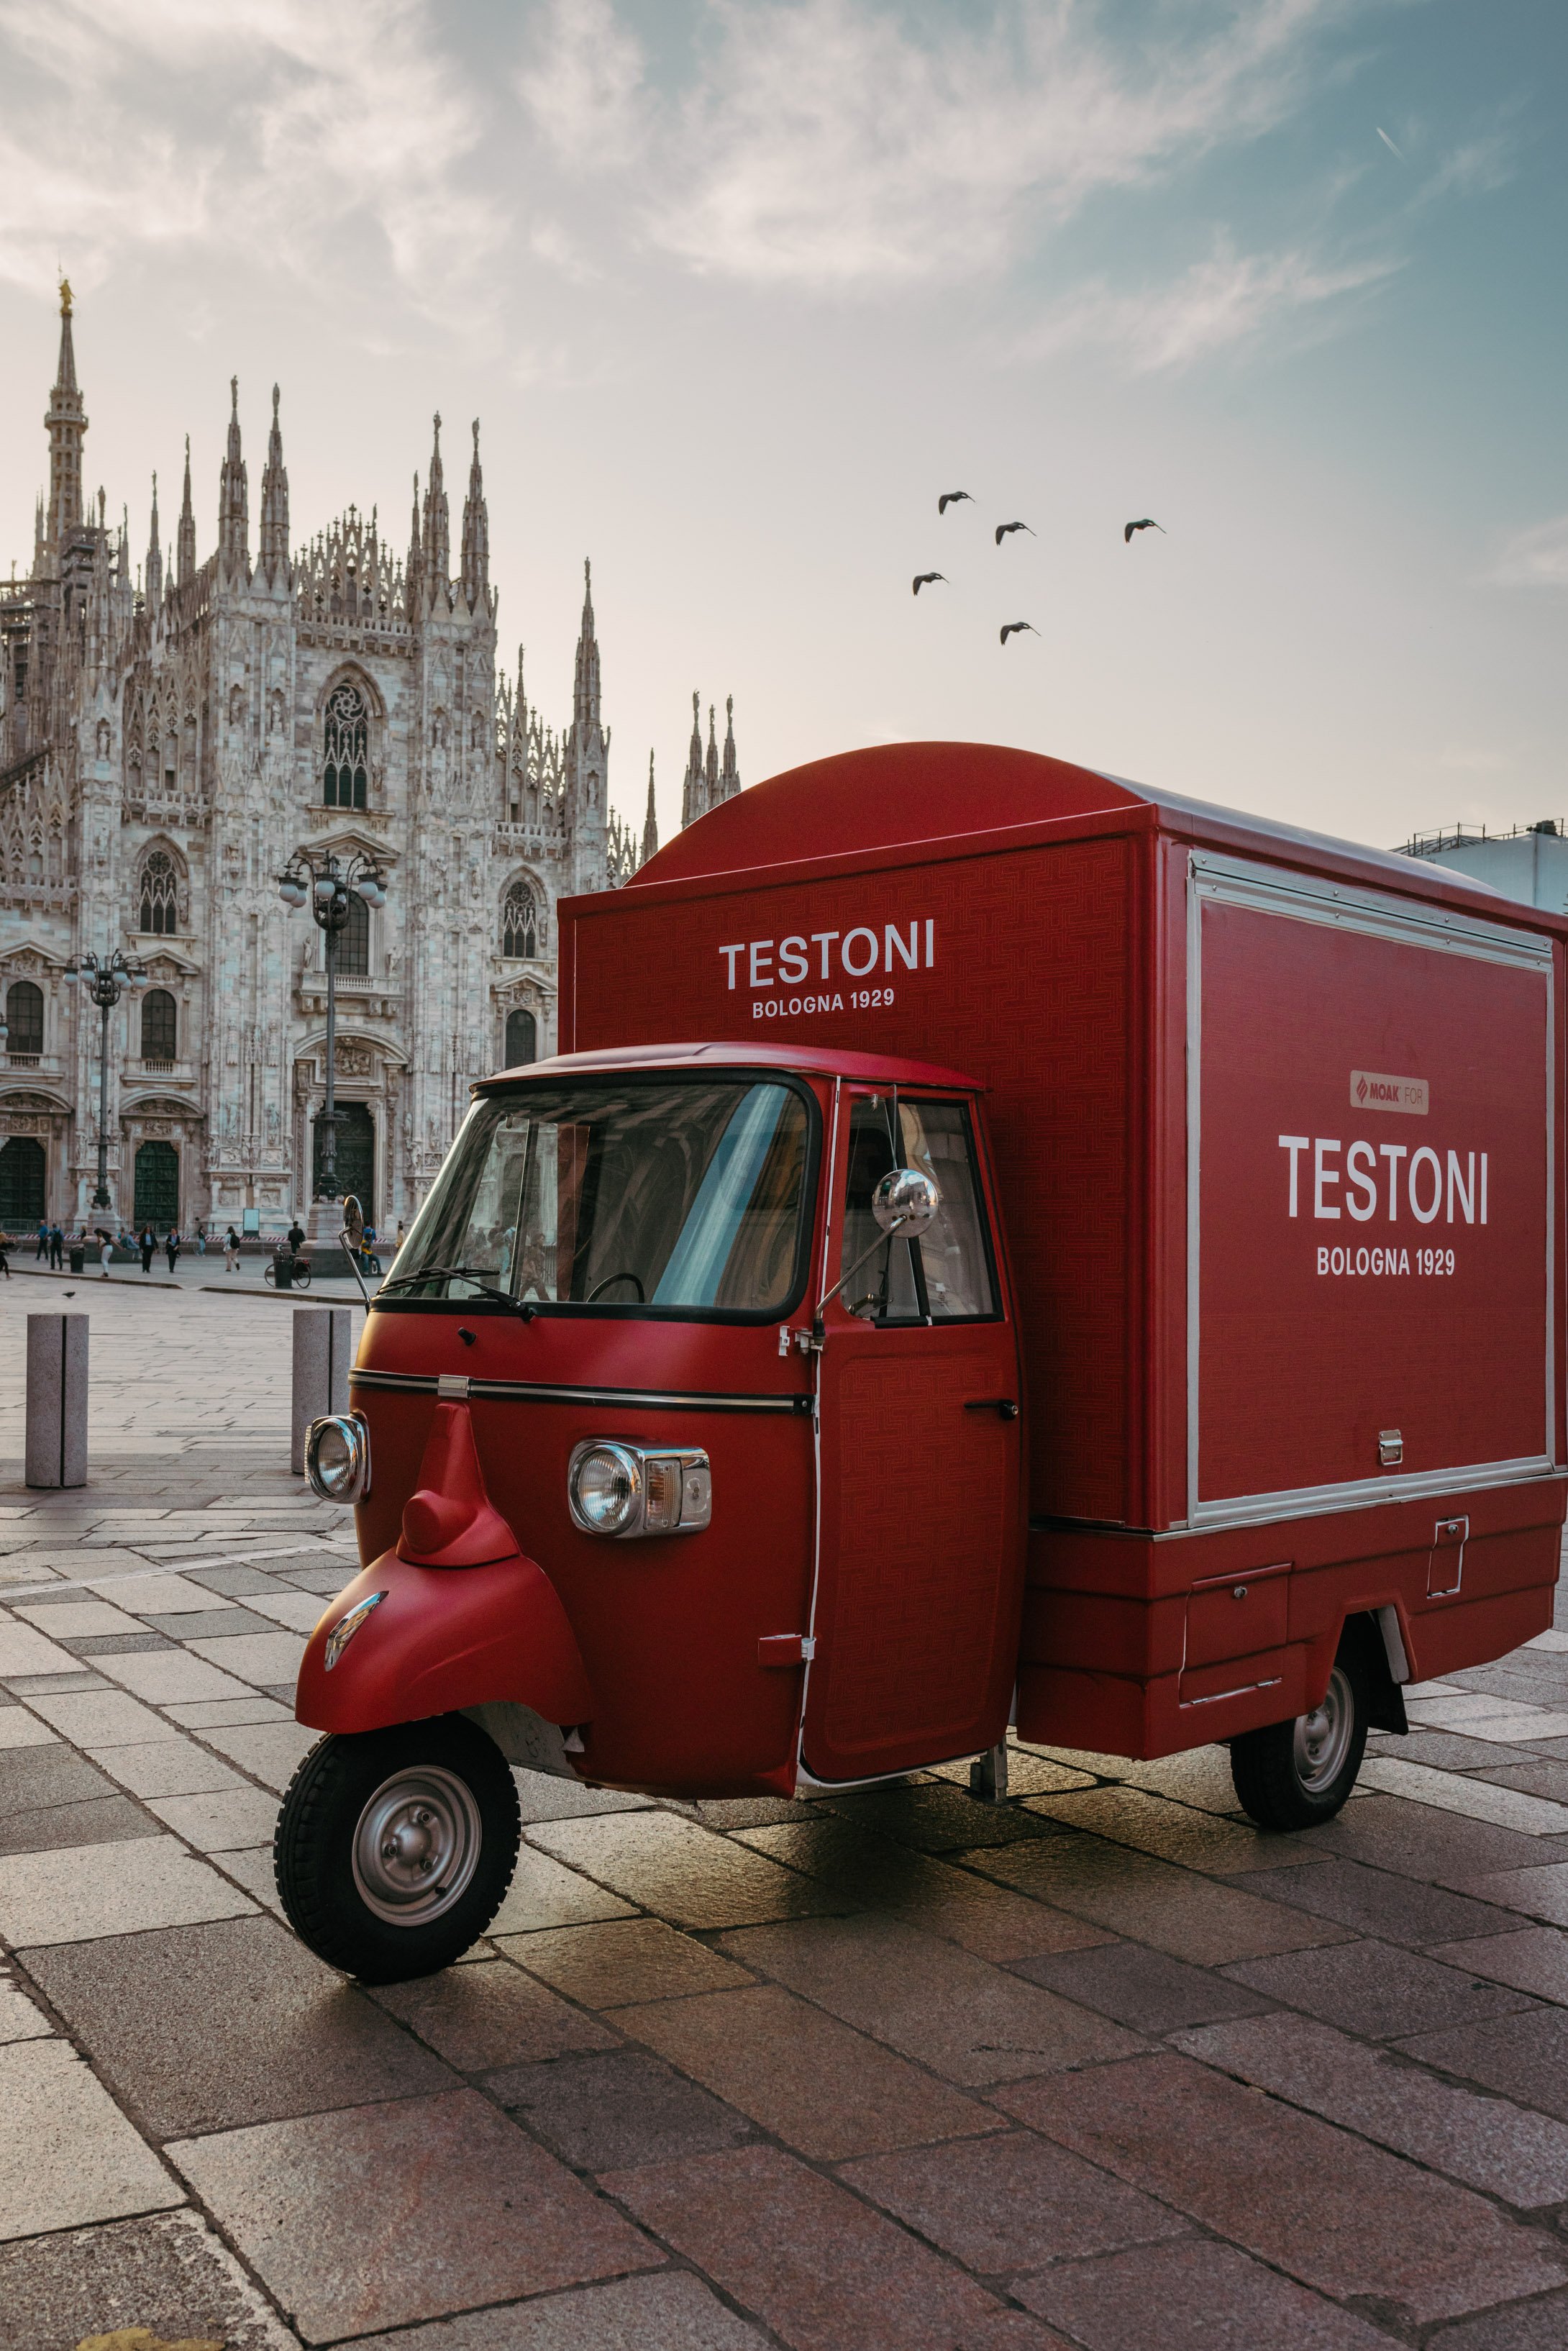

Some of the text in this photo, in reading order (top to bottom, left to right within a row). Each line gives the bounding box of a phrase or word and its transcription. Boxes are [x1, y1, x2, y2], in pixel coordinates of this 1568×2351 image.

[719, 919, 934, 990] TESTONI
[752, 988, 895, 1019] BOLOGNA 1929
[1369, 1082, 1423, 1105] MOAK FOR
[1278, 1134, 1488, 1224] TESTONI
[1317, 1247, 1455, 1276] BOLOGNA 1929
